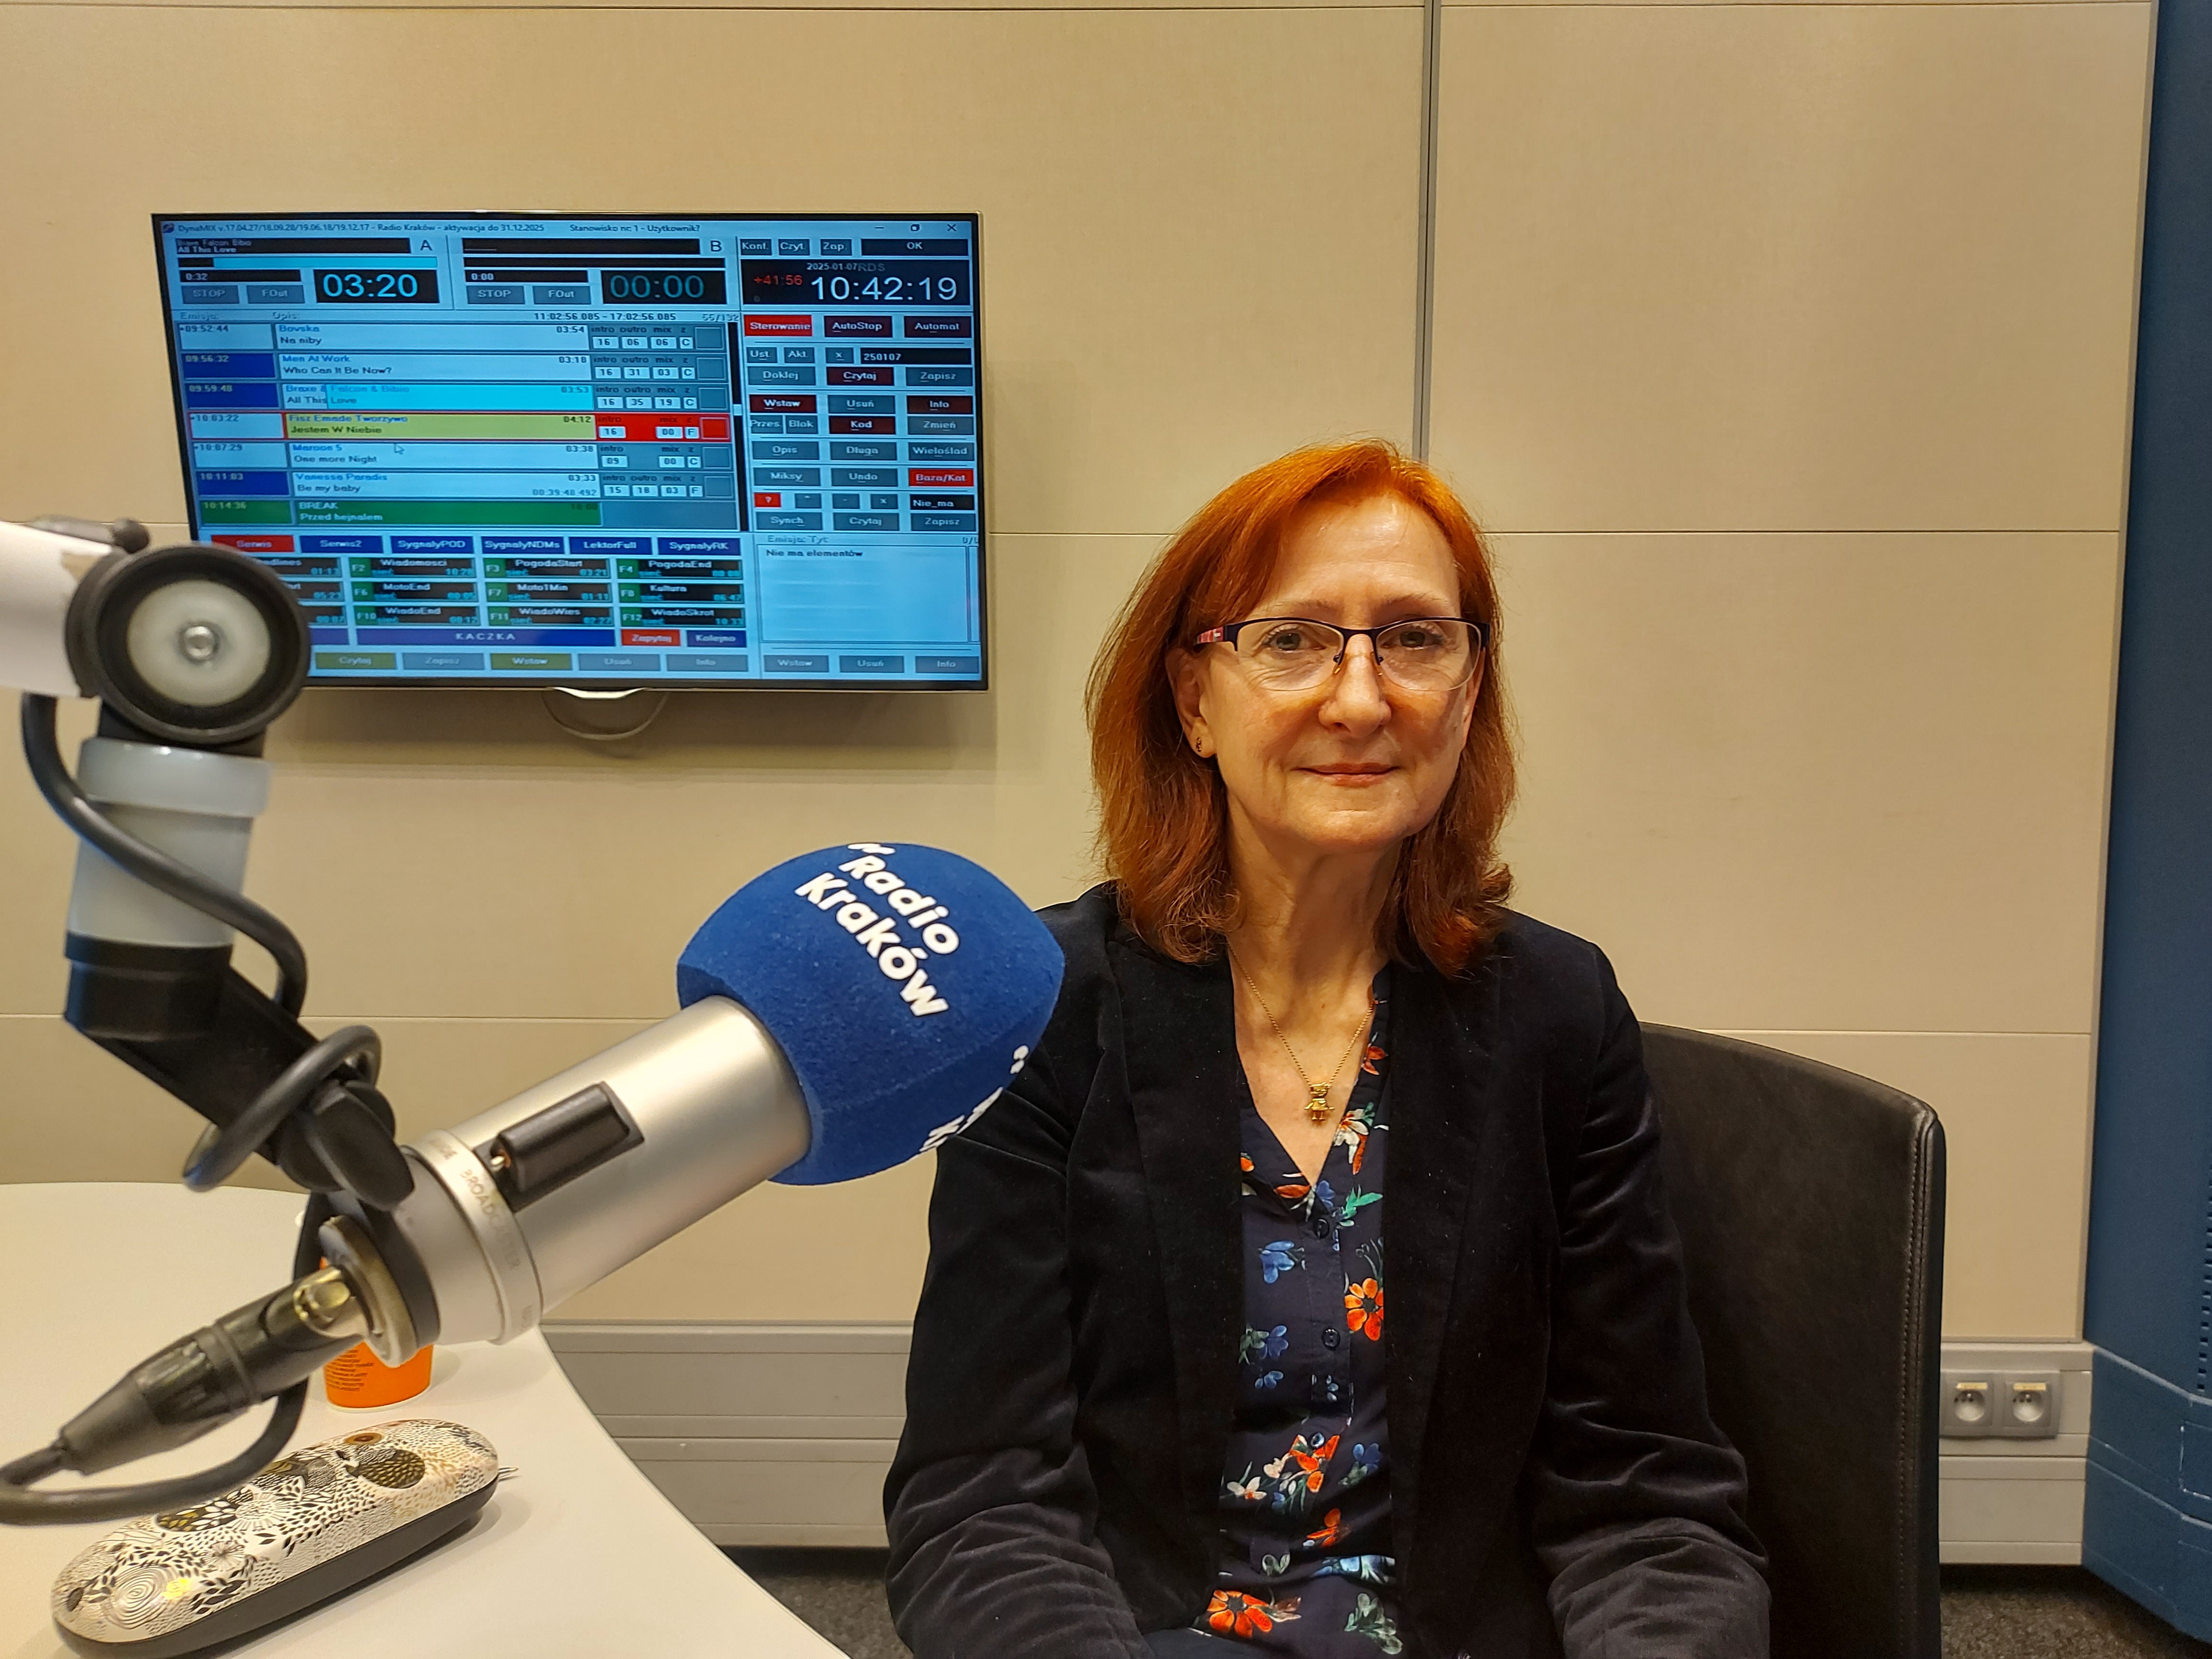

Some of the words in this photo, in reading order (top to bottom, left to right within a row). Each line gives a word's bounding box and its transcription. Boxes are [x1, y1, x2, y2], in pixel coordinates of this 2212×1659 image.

[420, 239, 433, 251] A
[710, 240, 722, 252] B
[754, 275, 803, 286] +41:56
[323, 274, 418, 297] 03:20
[610, 275, 704, 298] 00:00
[811, 276, 957, 300] 10:42:19
[192, 289, 226, 298] STOP
[478, 289, 512, 298] STOP
[548, 289, 575, 298] FOut
[750, 322, 811, 330] Sterowanie
[832, 322, 882, 331] AutoStop
[299, 336, 322, 345] niby
[763, 371, 798, 380] Doklej
[843, 371, 877, 381] Czytaj
[920, 372, 957, 381] Zapisz
[763, 399, 801, 407] Wstaw
[923, 420, 956, 429] Zmień
[772, 445, 798, 455] Opis
[348, 455, 377, 464] Night
[770, 473, 803, 481] Miksy
[333, 485, 362, 493] baby
[913, 499, 954, 508] Nie_ma
[849, 517, 882, 526] Czytaj
[924, 518, 960, 526] Zapisz
[622, 613, 642, 621] F12
[838, 854, 960, 955] Radio
[794, 872, 950, 1017] Kraków
